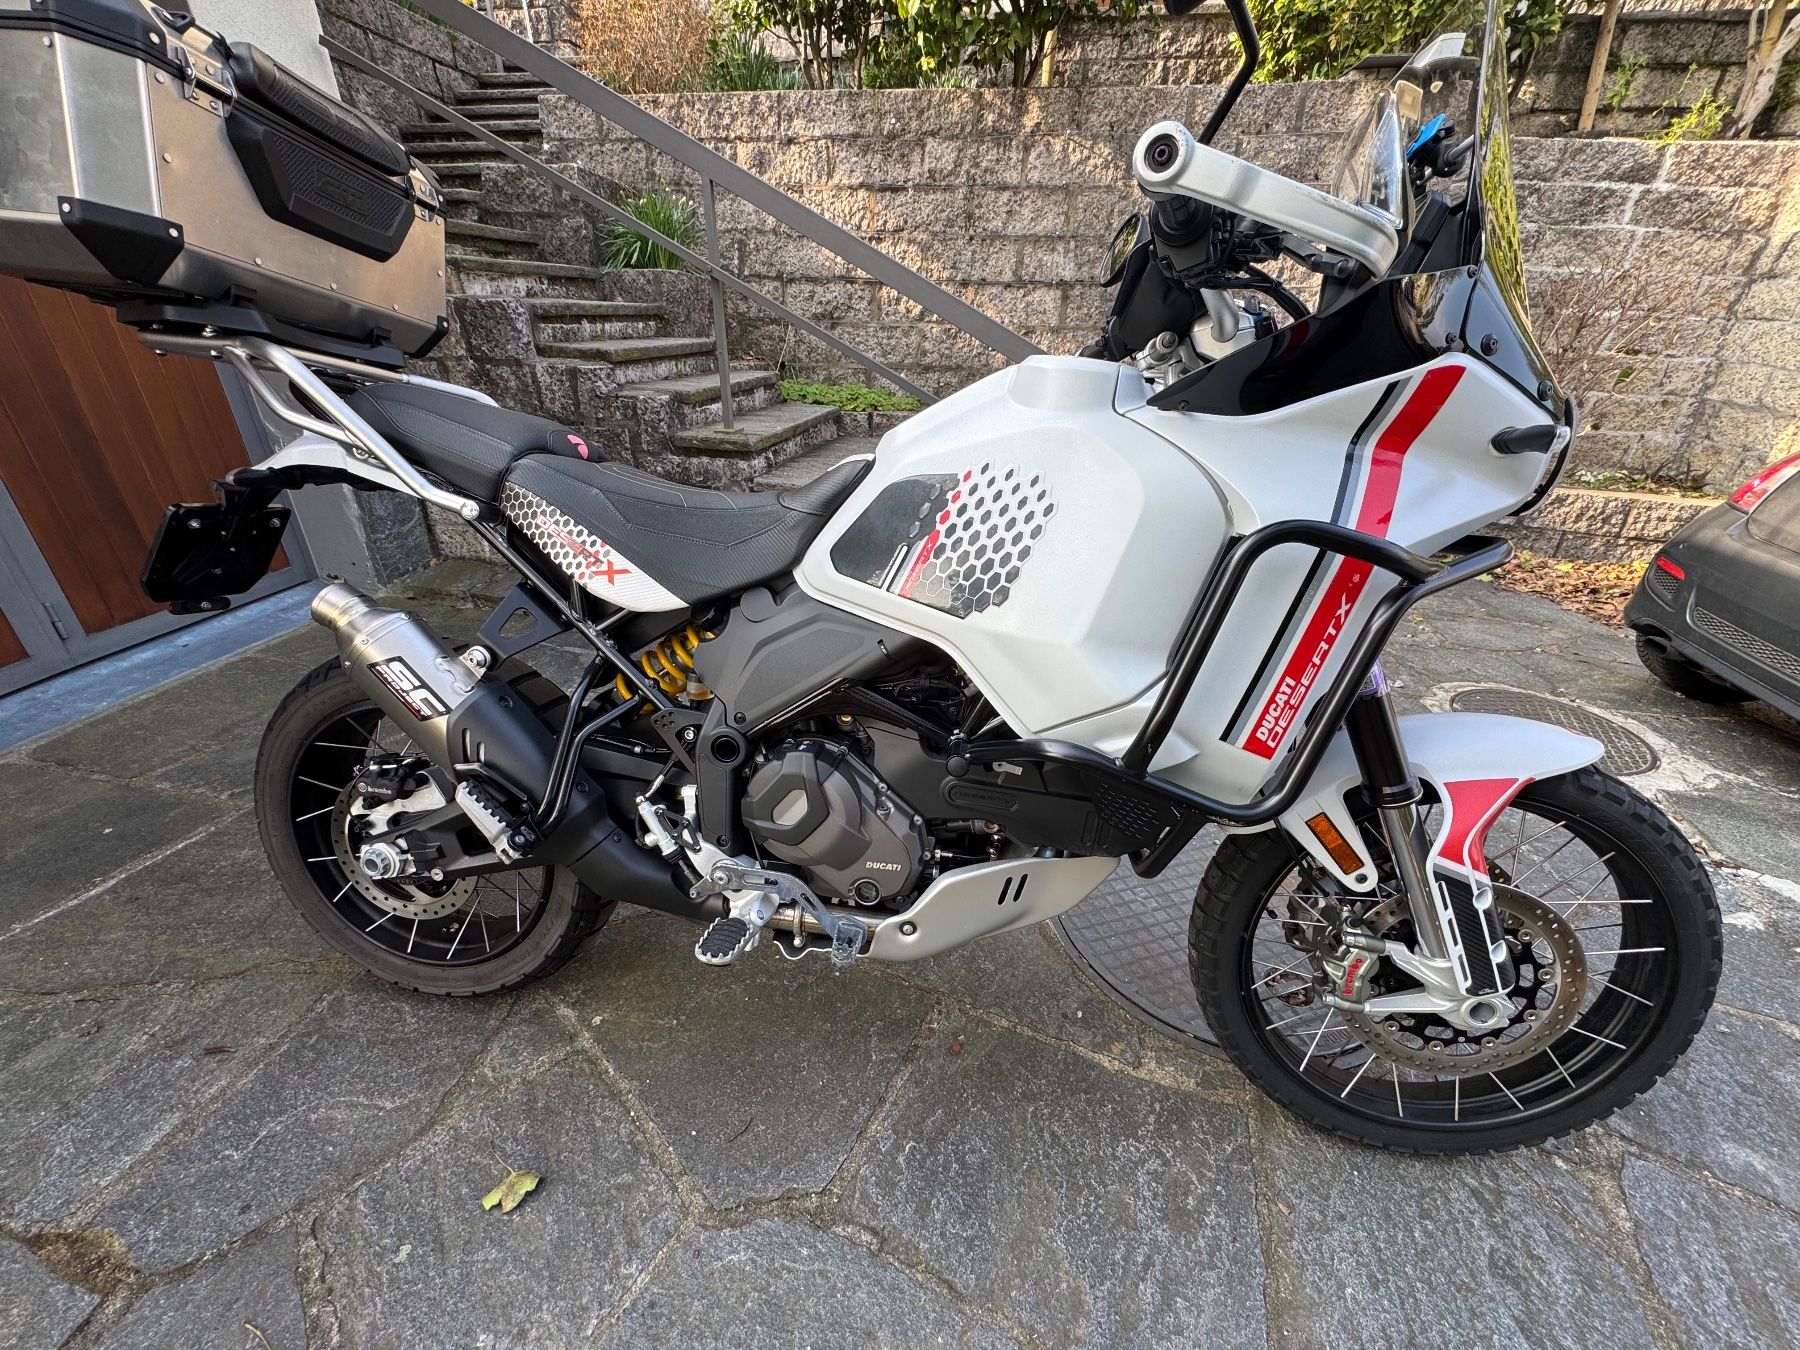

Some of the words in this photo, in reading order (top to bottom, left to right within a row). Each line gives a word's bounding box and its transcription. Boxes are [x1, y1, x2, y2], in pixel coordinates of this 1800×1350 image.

[375, 665, 428, 717] PROJECT
[381, 661, 446, 716] SC
[1266, 592, 1352, 748] DESERTX
[1255, 676, 1296, 741] DUCATI
[367, 785, 392, 795] brembo
[865, 861, 902, 871] DUCATI
[1343, 957, 1363, 996] brembo
